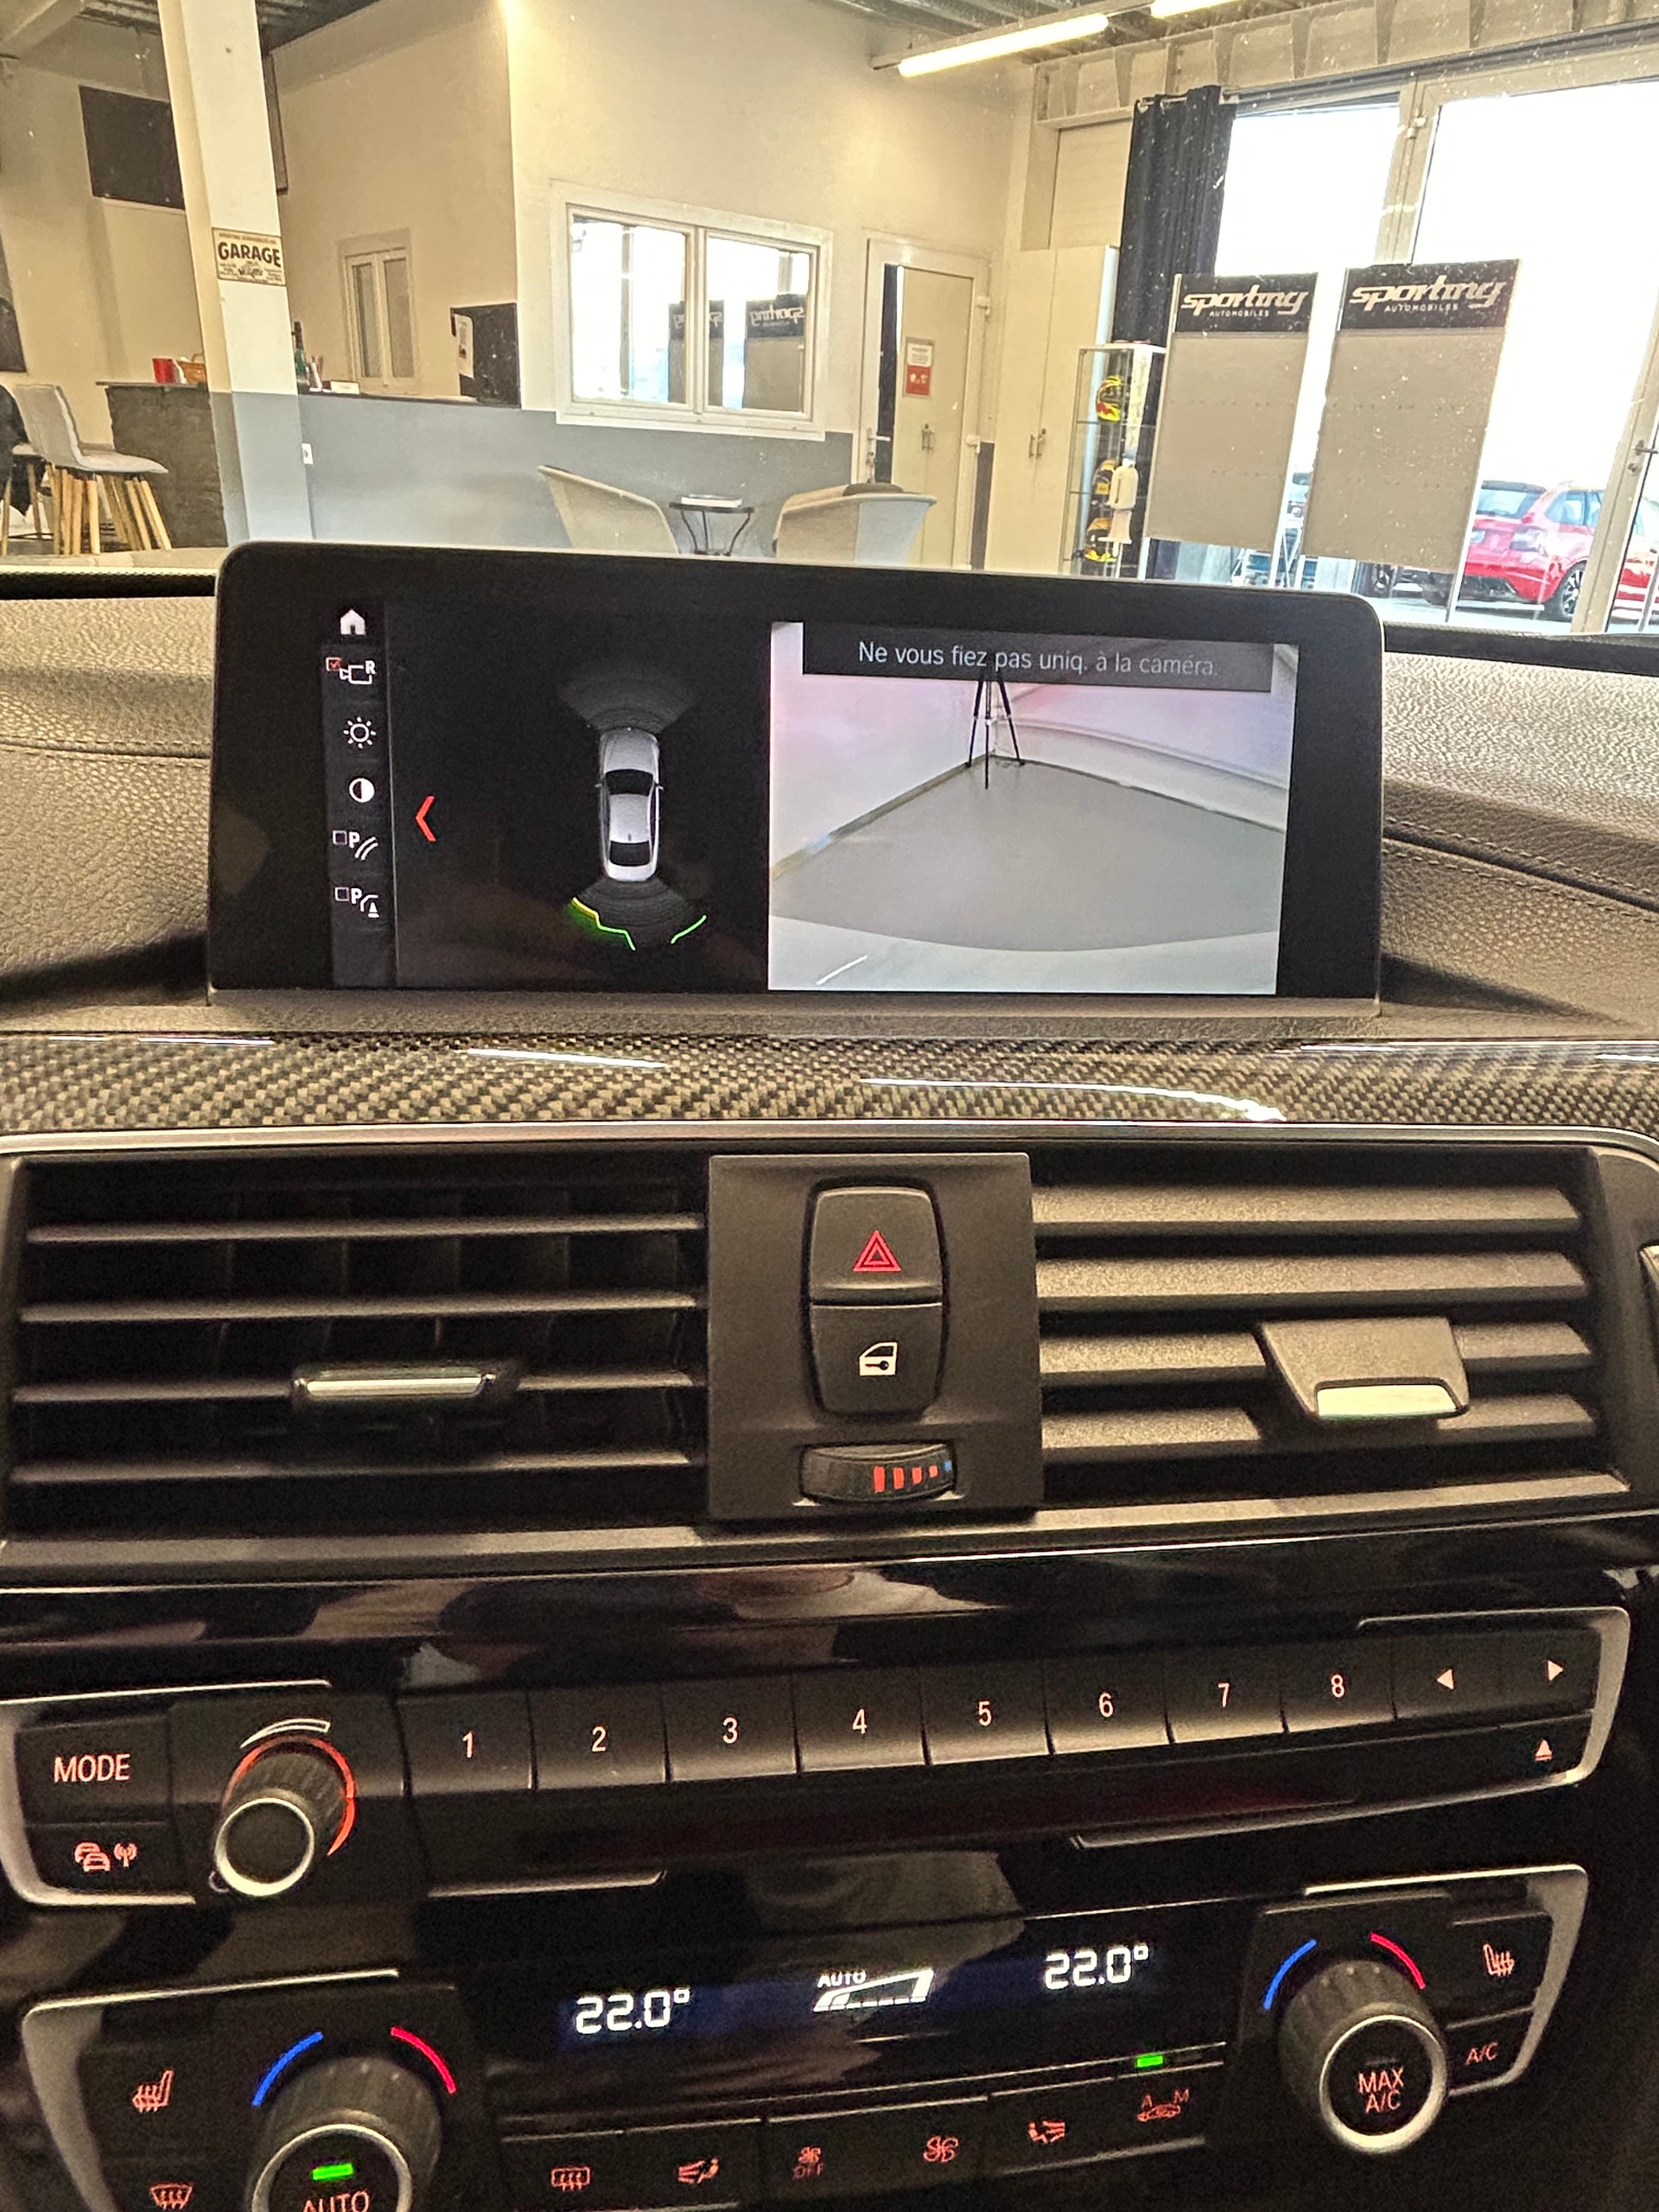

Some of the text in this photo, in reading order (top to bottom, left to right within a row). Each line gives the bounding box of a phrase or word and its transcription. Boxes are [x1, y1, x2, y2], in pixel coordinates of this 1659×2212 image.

[218, 241, 282, 268] GARAGE
[1384, 303, 1459, 313] AUTOMOBILES
[858, 641, 1219, 677] Ne vous fiez pas uniq. à la caméra.
[1218, 1682, 1230, 1707] 7
[1330, 1674, 1344, 1698] 8
[977, 1700, 993, 1726] 5
[1098, 1692, 1114, 1718] 6
[722, 1717, 739, 1744] 3
[852, 1708, 868, 1734] 4
[462, 1732, 475, 1758] 1
[591, 1726, 607, 1751] 2
[53, 1753, 130, 1783] MODE
[817, 1971, 867, 1987] AUTO
[1465, 2042, 1500, 2065] A/C
[1357, 2068, 1405, 2094] MAX
[1364, 2089, 1403, 2113] A/C
